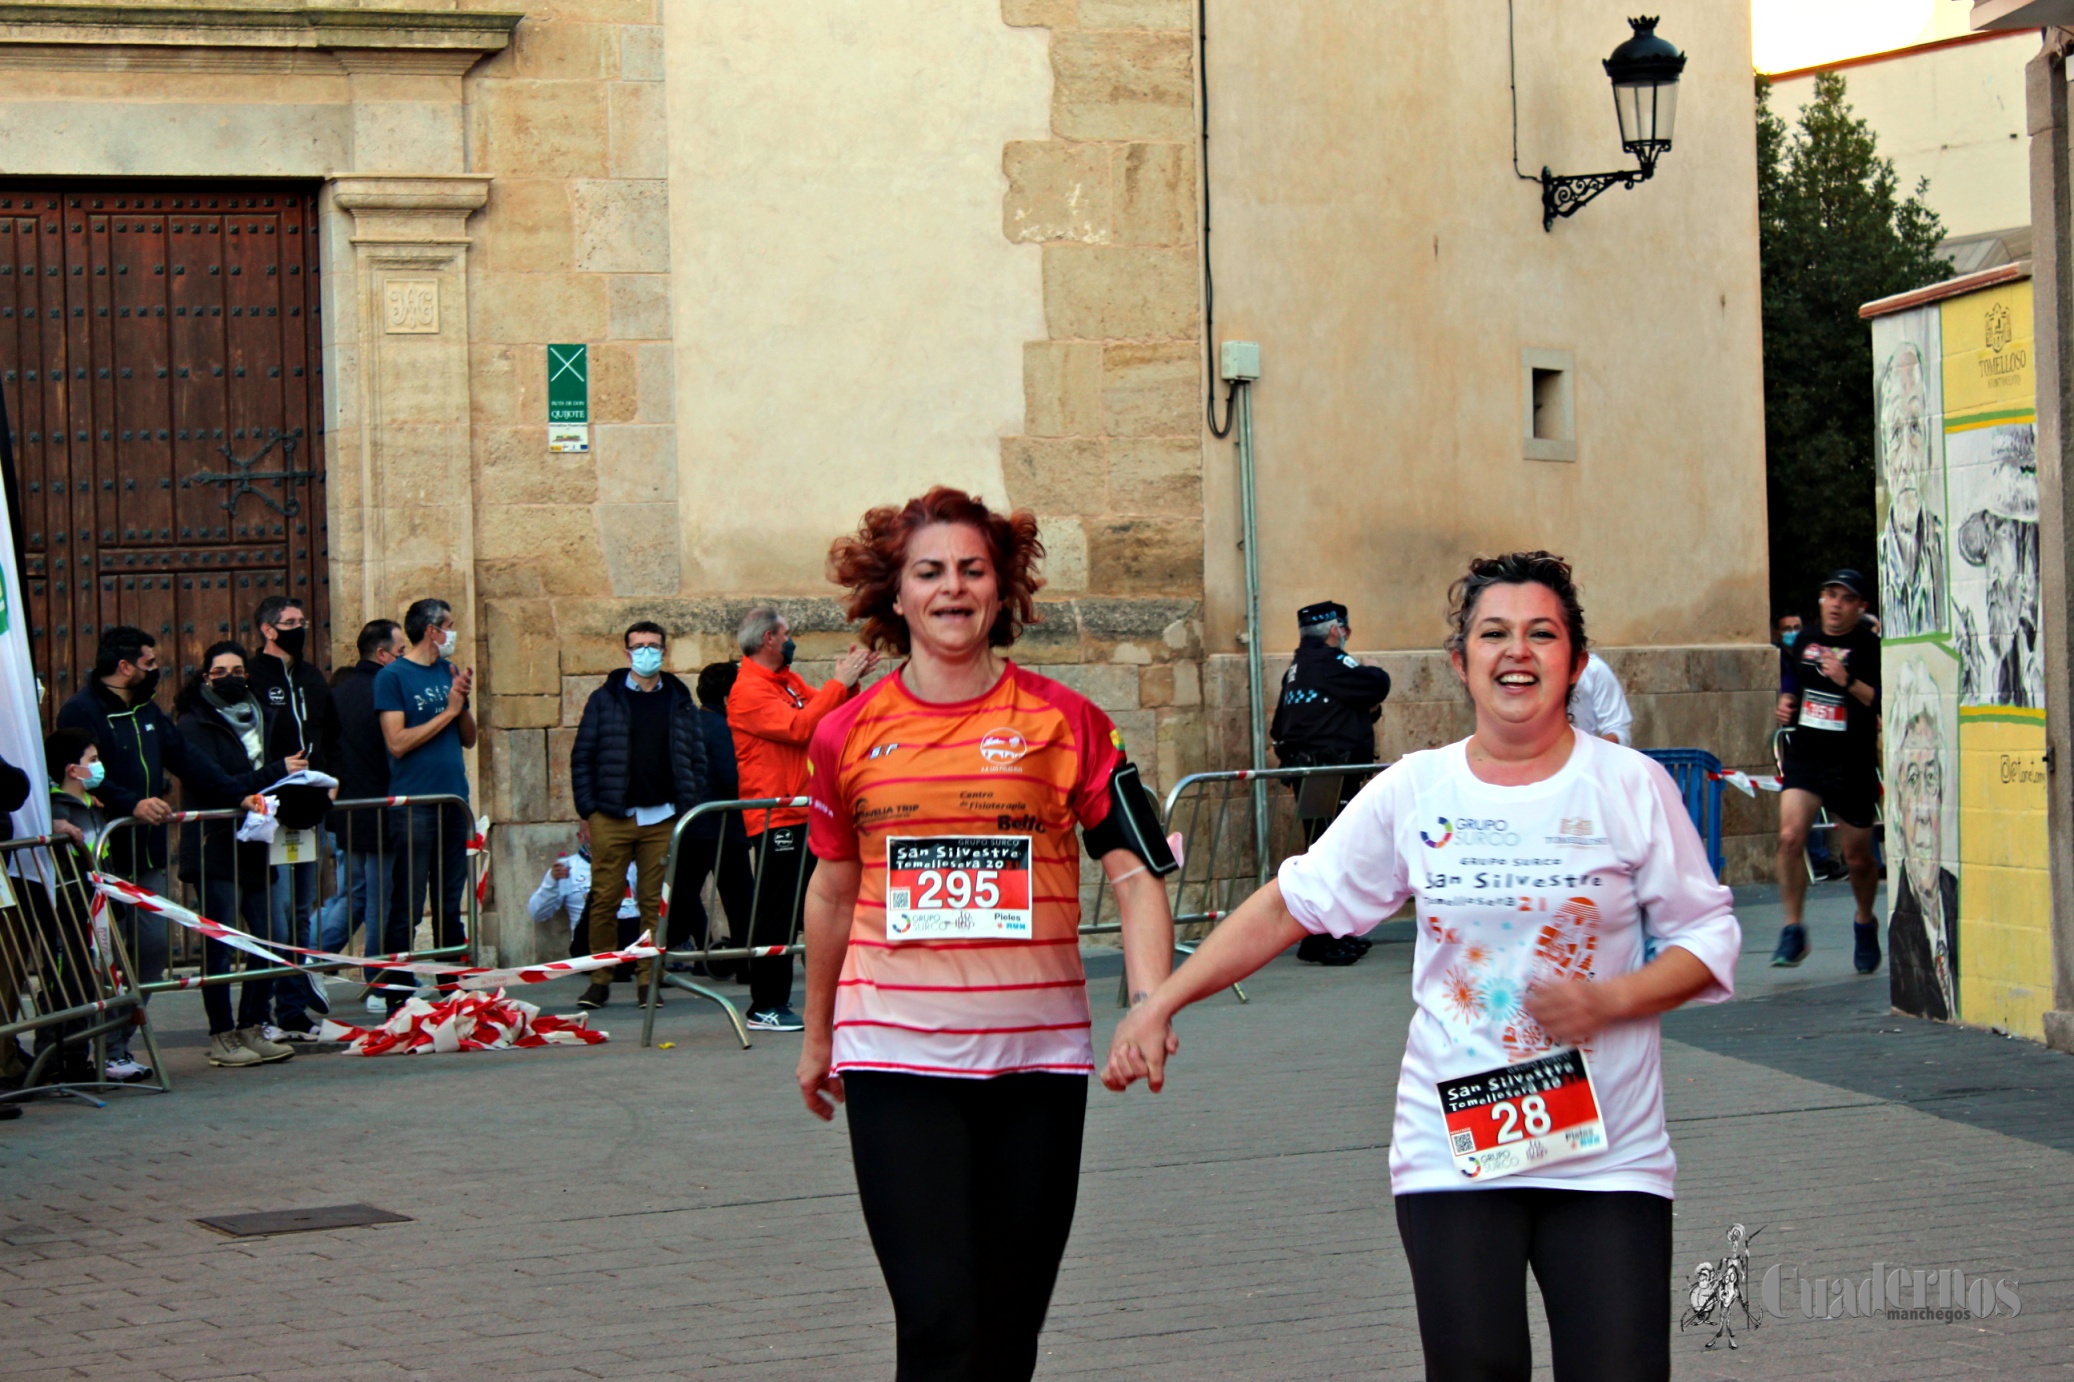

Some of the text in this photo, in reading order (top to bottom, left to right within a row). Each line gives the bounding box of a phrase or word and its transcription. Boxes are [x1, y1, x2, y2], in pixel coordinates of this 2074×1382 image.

[1979, 350, 2026, 378] TOMELLOSO
[551, 410, 586, 420] QUIJOTE
[960, 791, 993, 799] Centro
[897, 804, 919, 812] TRIP
[1455, 818, 1508, 831] GRUPO
[1454, 832, 1521, 846] SURCO
[897, 846, 1021, 860] San Silvestre
[896, 859, 981, 870] Tomellosera
[1473, 872, 1603, 889] Silvestre
[917, 870, 1000, 909] 295
[912, 914, 941, 922] GRUPO
[994, 912, 1021, 921] Pieles
[912, 921, 948, 932] SURCO
[1447, 1083, 1482, 1101] San
[1491, 1094, 1552, 1146] 28
[1480, 1150, 1511, 1164] GRUPO
[1483, 1157, 1521, 1173] SURCO
